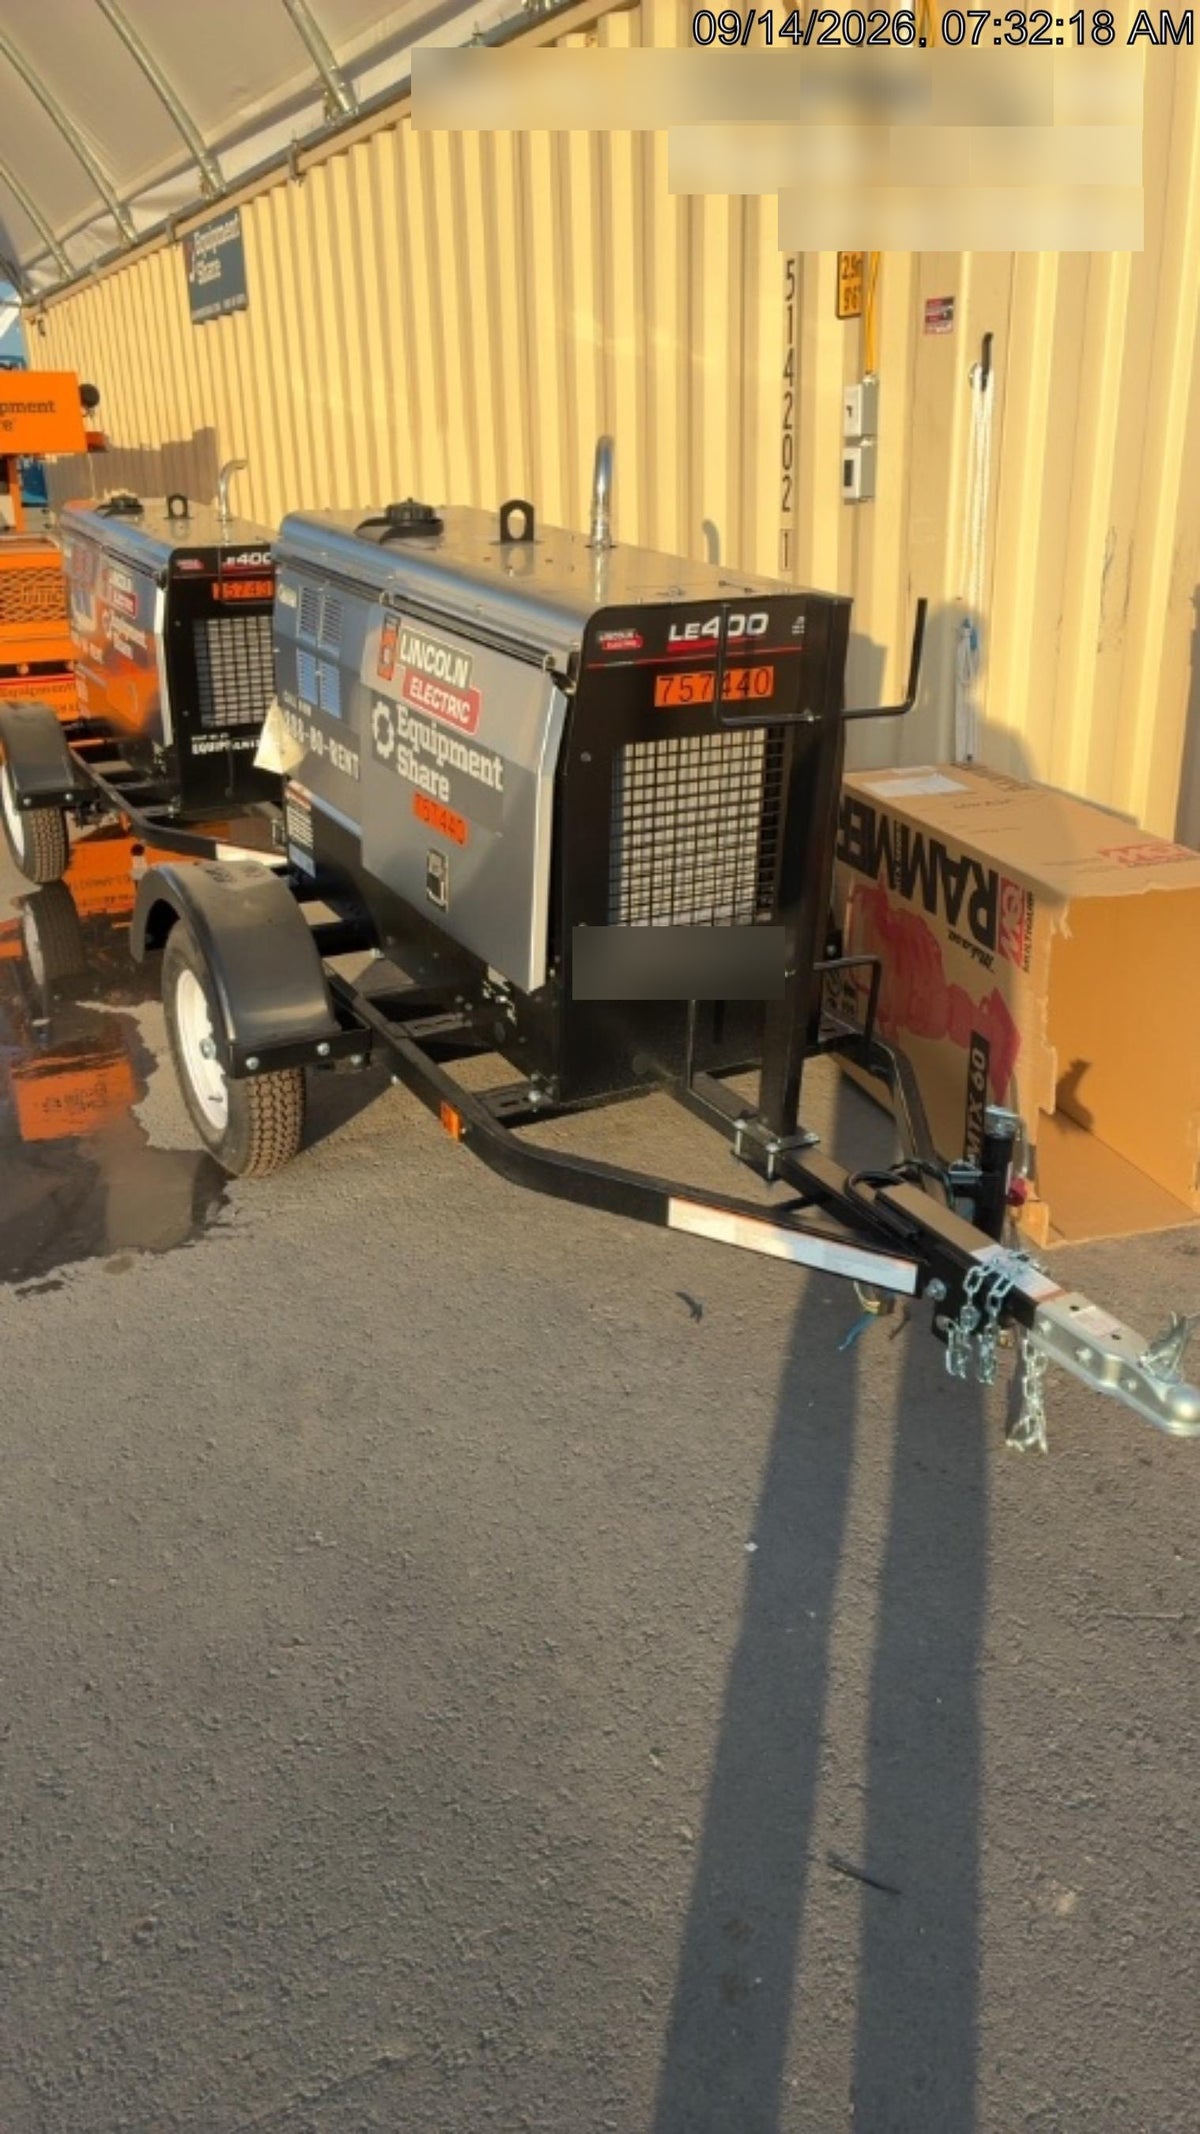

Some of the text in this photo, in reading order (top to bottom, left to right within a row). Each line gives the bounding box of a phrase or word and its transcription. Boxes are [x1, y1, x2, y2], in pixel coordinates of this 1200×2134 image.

[669, 613, 769, 641] LE400
[400, 633, 468, 689] LINCOLN
[409, 676, 471, 724] ELECTRIC
[397, 703, 503, 791] Equipment
[398, 742, 450, 803] Share
